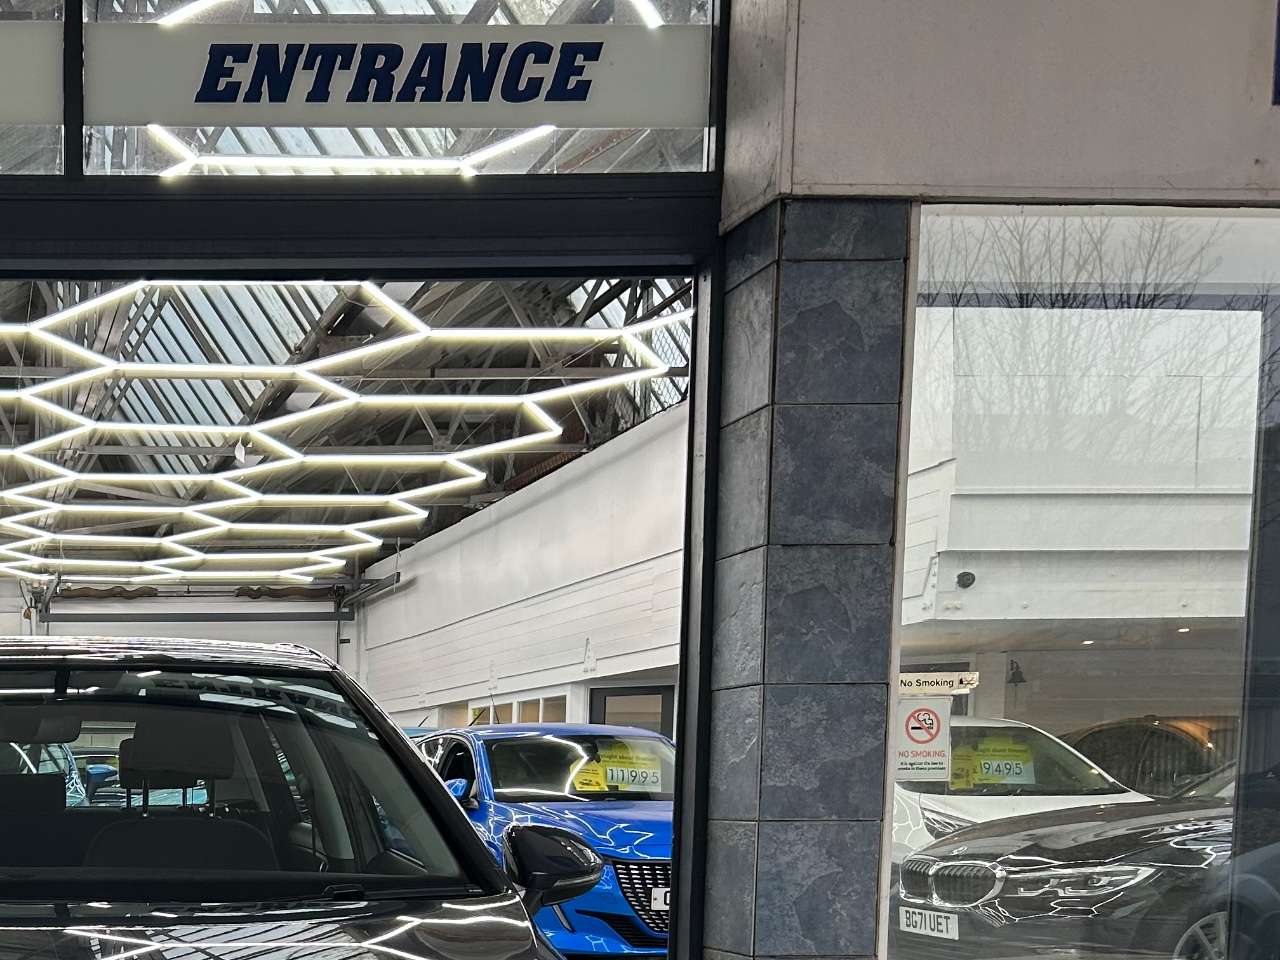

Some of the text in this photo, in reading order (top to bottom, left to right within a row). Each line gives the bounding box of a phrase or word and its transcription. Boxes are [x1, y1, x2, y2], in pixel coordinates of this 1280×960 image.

[194, 41, 604, 103] ENTRANCE
[900, 679, 954, 688] No Smoking
[898, 750, 910, 758] NO
[911, 750, 946, 758] SMOKING
[608, 768, 659, 784] 11995
[929, 913, 950, 934] UET
